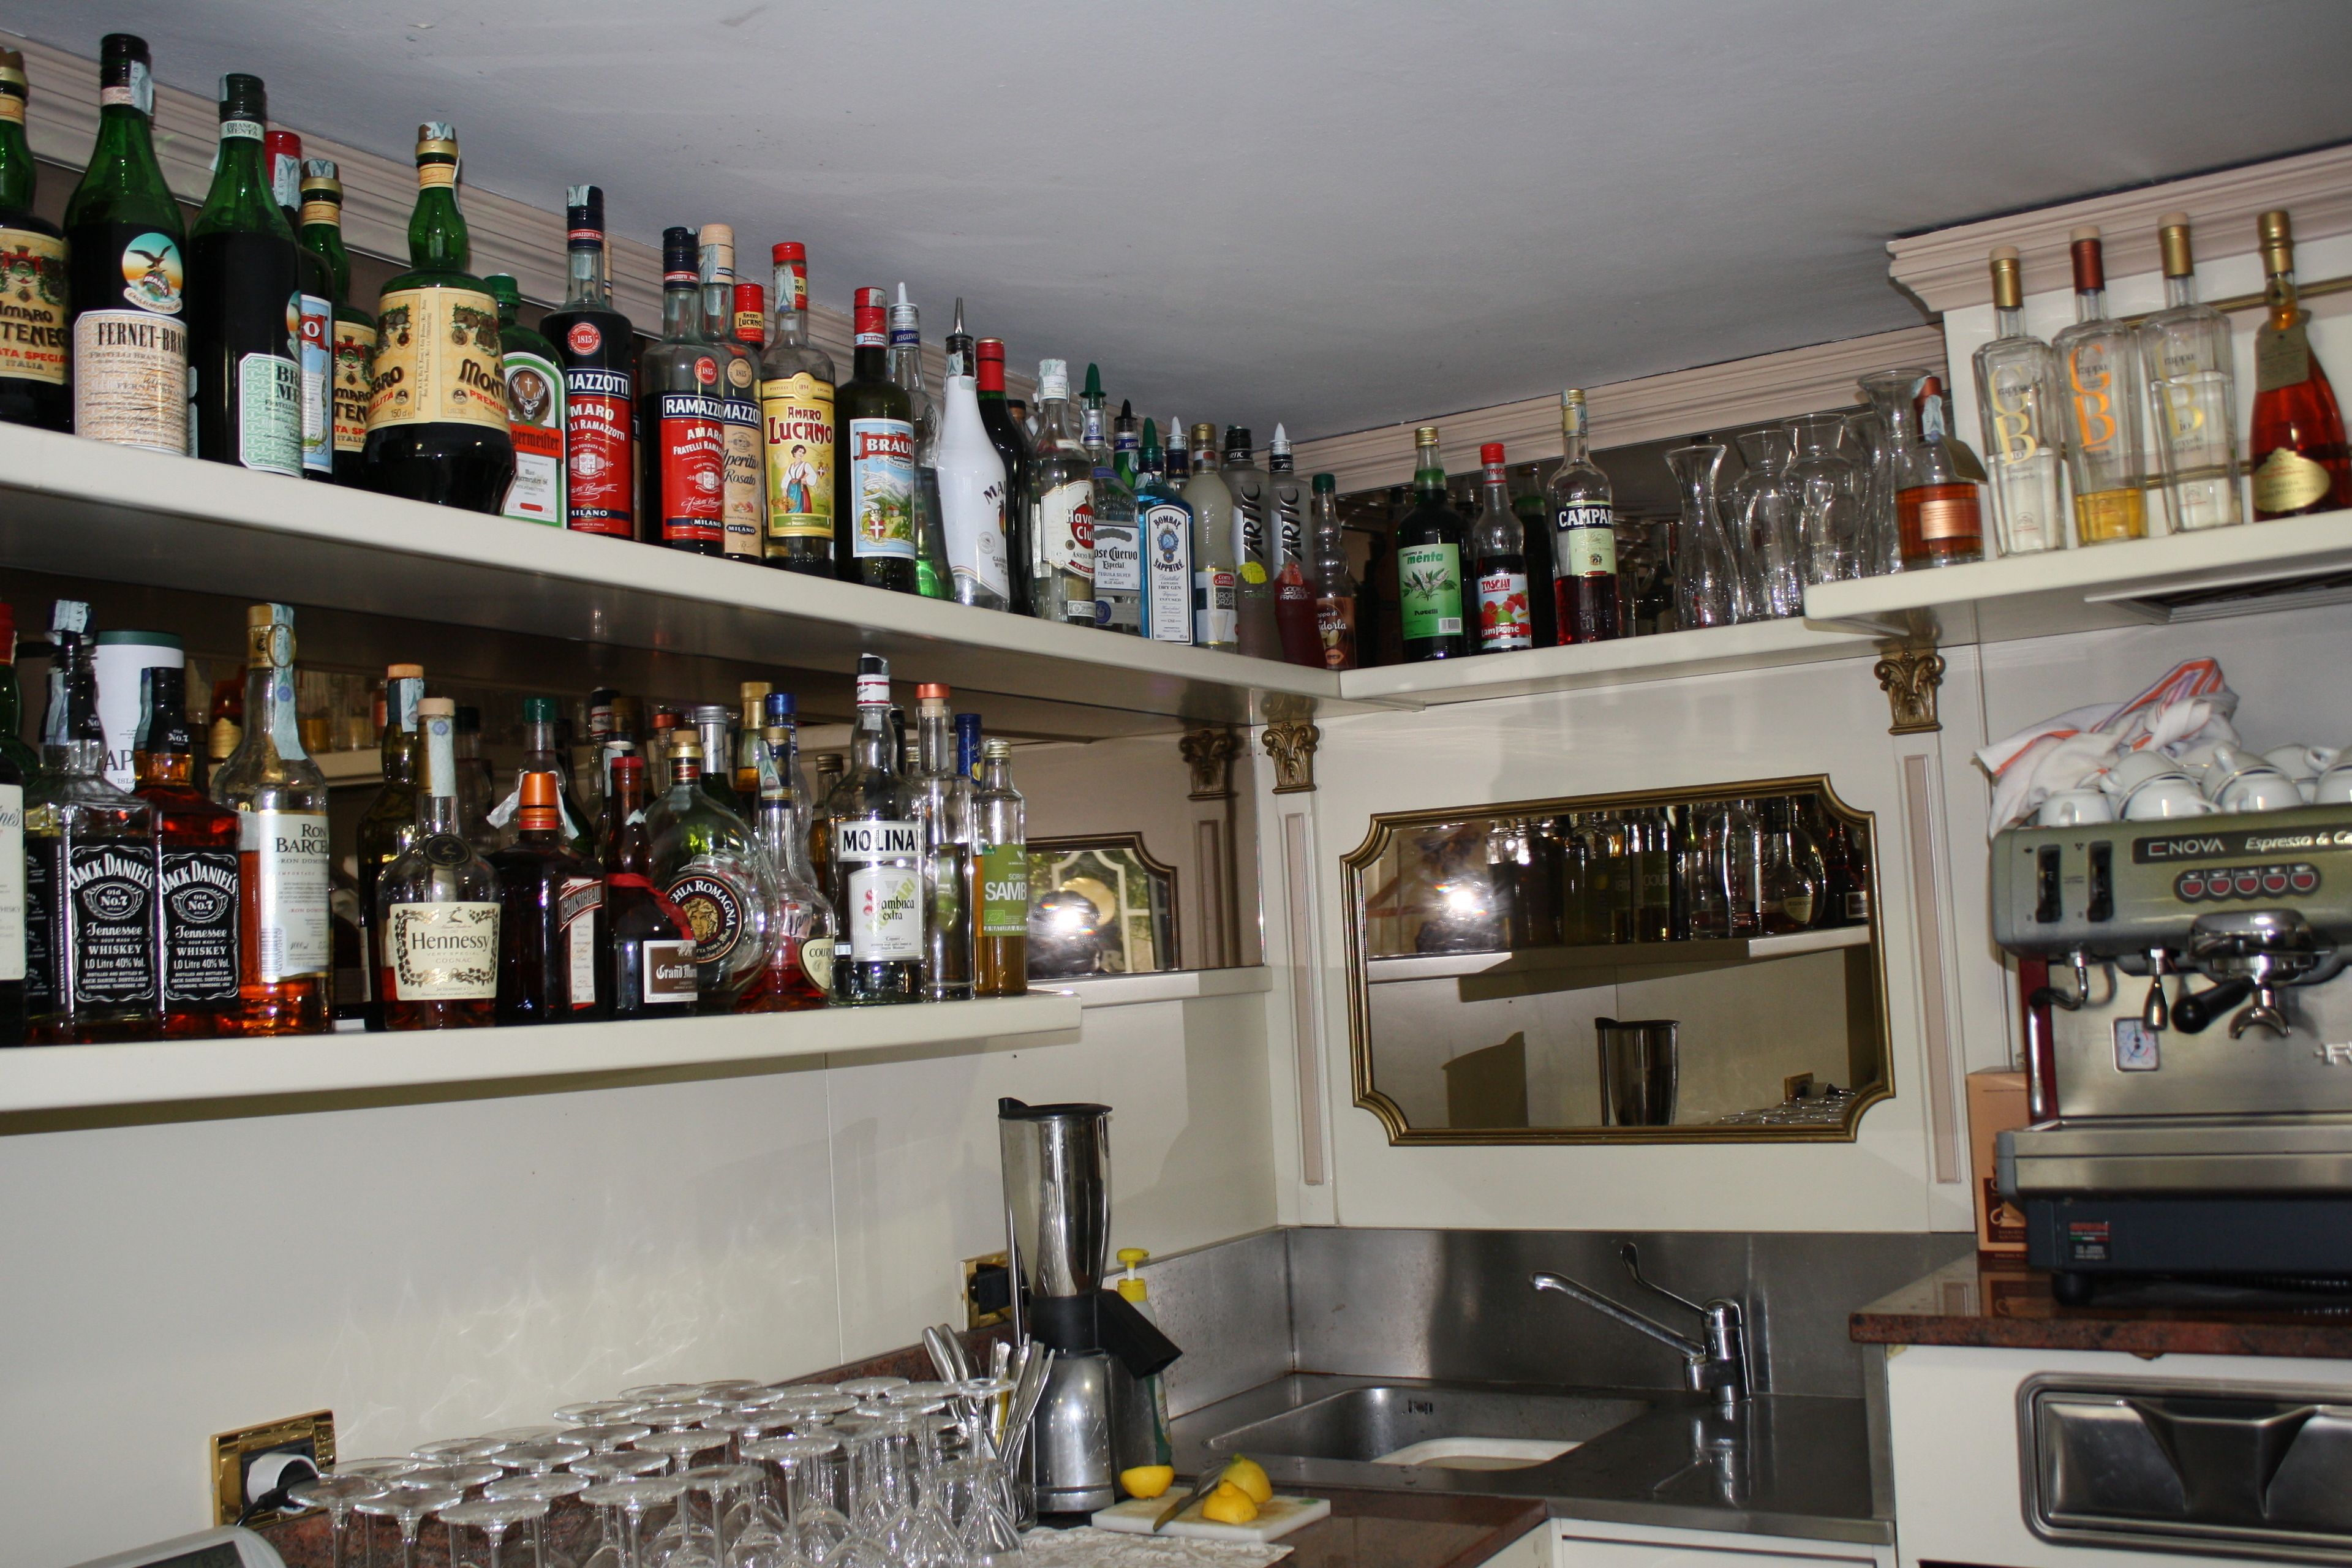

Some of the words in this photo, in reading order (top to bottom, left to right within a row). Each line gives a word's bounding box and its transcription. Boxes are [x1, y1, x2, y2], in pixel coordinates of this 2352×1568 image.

[738, 318, 763, 327] LUCANO
[578, 335, 593, 344] 1815
[788, 406, 821, 421] AMARO
[580, 419, 625, 441] RAMAZZOTTI
[768, 417, 832, 444] LUCANO
[674, 442, 703, 455] FRATELLI
[694, 519, 722, 527] MILANO
[1153, 515, 1182, 530] BOMBAY
[1241, 483, 1263, 560] ARTIC
[1280, 488, 1303, 562] ARTIC
[1109, 546, 1137, 561] Cuervo
[1407, 551, 1444, 565] menta
[1153, 558, 1185, 573] SAPPHIRE
[1481, 578, 1510, 591] TOSCHI
[2245, 835, 2316, 853] Espresso
[70, 858, 105, 890] JACK
[104, 853, 153, 890] DANIEL'S
[160, 867, 190, 895] JACK
[190, 860, 238, 895] DANIEL'S
[100, 894, 129, 907] No.7
[187, 900, 214, 911] No.7
[561, 886, 601, 925] COINTREAU
[695, 880, 736, 926] ROMAGNA
[883, 910, 903, 921] extra
[86, 922, 143, 937] Tennessee
[175, 925, 227, 939] Tennessee
[88, 944, 143, 955] WHISKEY
[412, 932, 491, 952] Hennessy
[176, 946, 227, 956] WHISKEY
[97, 958, 114, 968] Litre
[115, 957, 132, 968] 40%
[184, 959, 201, 969] Litre
[202, 959, 217, 969] 40%
